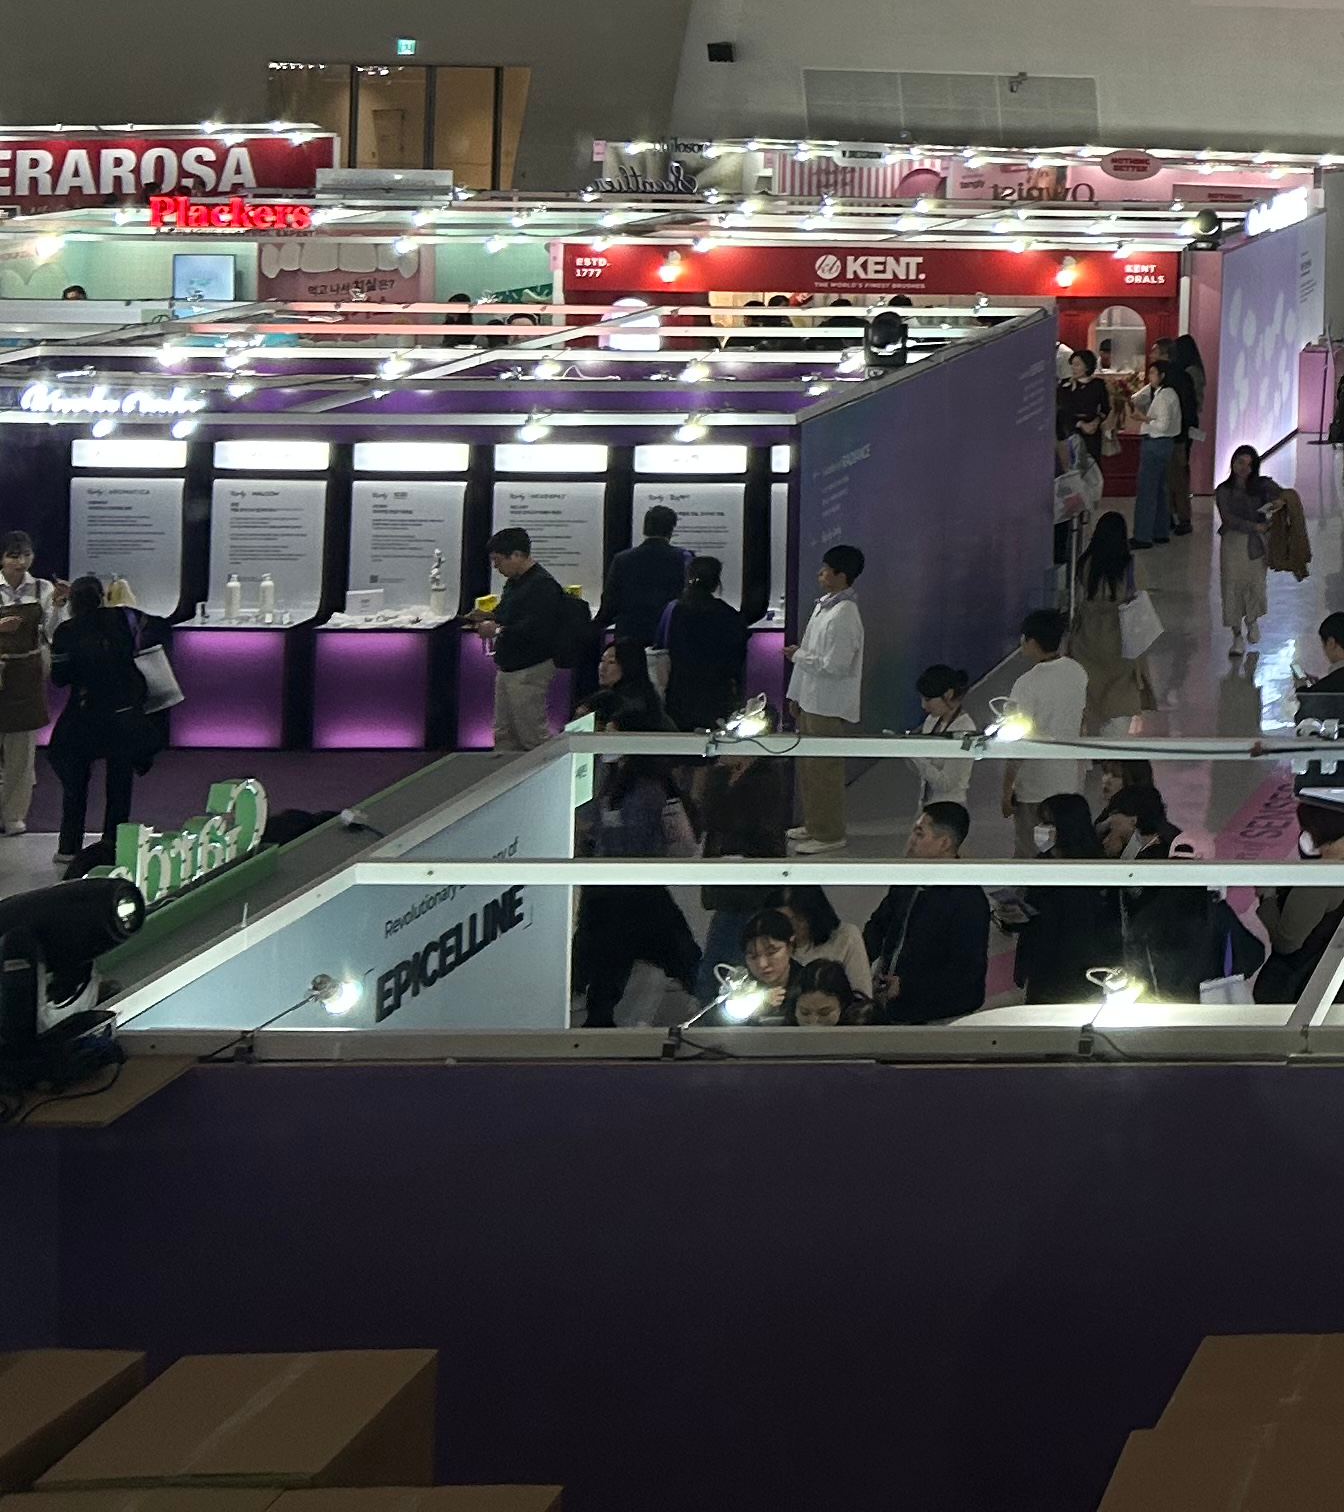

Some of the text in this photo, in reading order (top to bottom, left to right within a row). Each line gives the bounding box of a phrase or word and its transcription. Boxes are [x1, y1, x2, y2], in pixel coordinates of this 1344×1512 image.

[1110, 157, 1150, 165] NOTHING
[1113, 165, 1148, 173] BETTER
[148, 195, 312, 229] Plackers
[575, 257, 610, 267] ESTD.
[846, 255, 927, 279] KENT.
[1124, 264, 1157, 273] KENT
[575, 269, 602, 277] 1777
[1124, 275, 1165, 284] ORALS
[375, 884, 526, 1024] EPICELLINE
